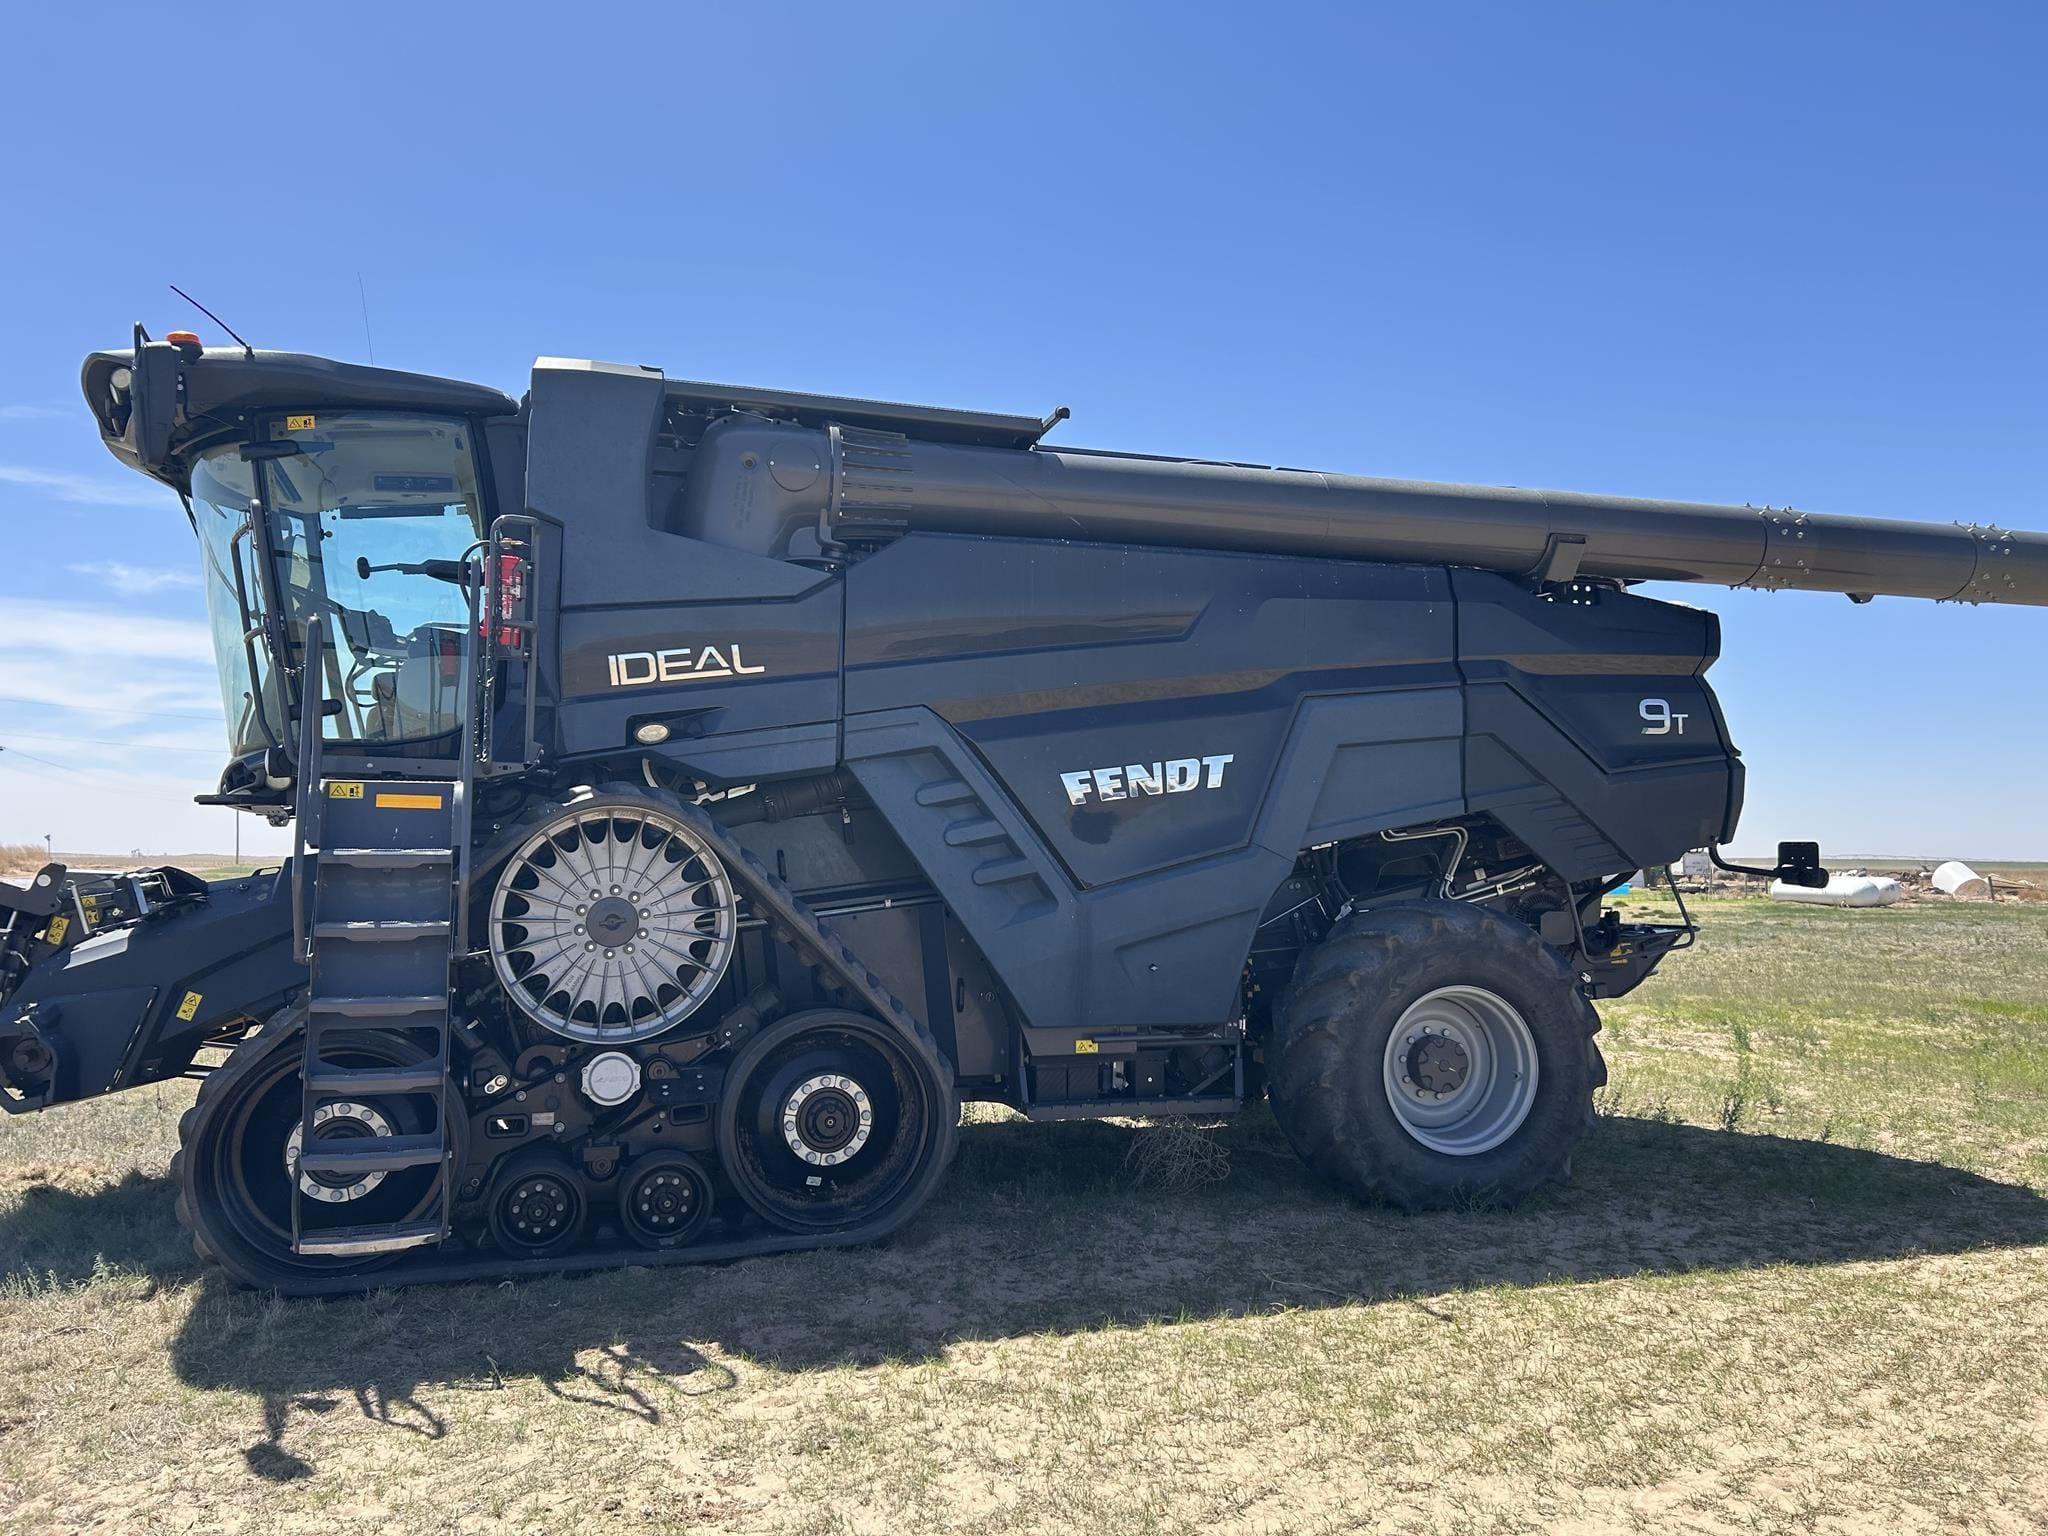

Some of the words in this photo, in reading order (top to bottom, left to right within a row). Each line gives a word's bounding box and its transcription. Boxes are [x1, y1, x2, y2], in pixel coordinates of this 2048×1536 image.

[607, 644, 765, 686] IDEAL
[1639, 698, 1689, 735] 9T
[1060, 754, 1234, 806] FENDT
